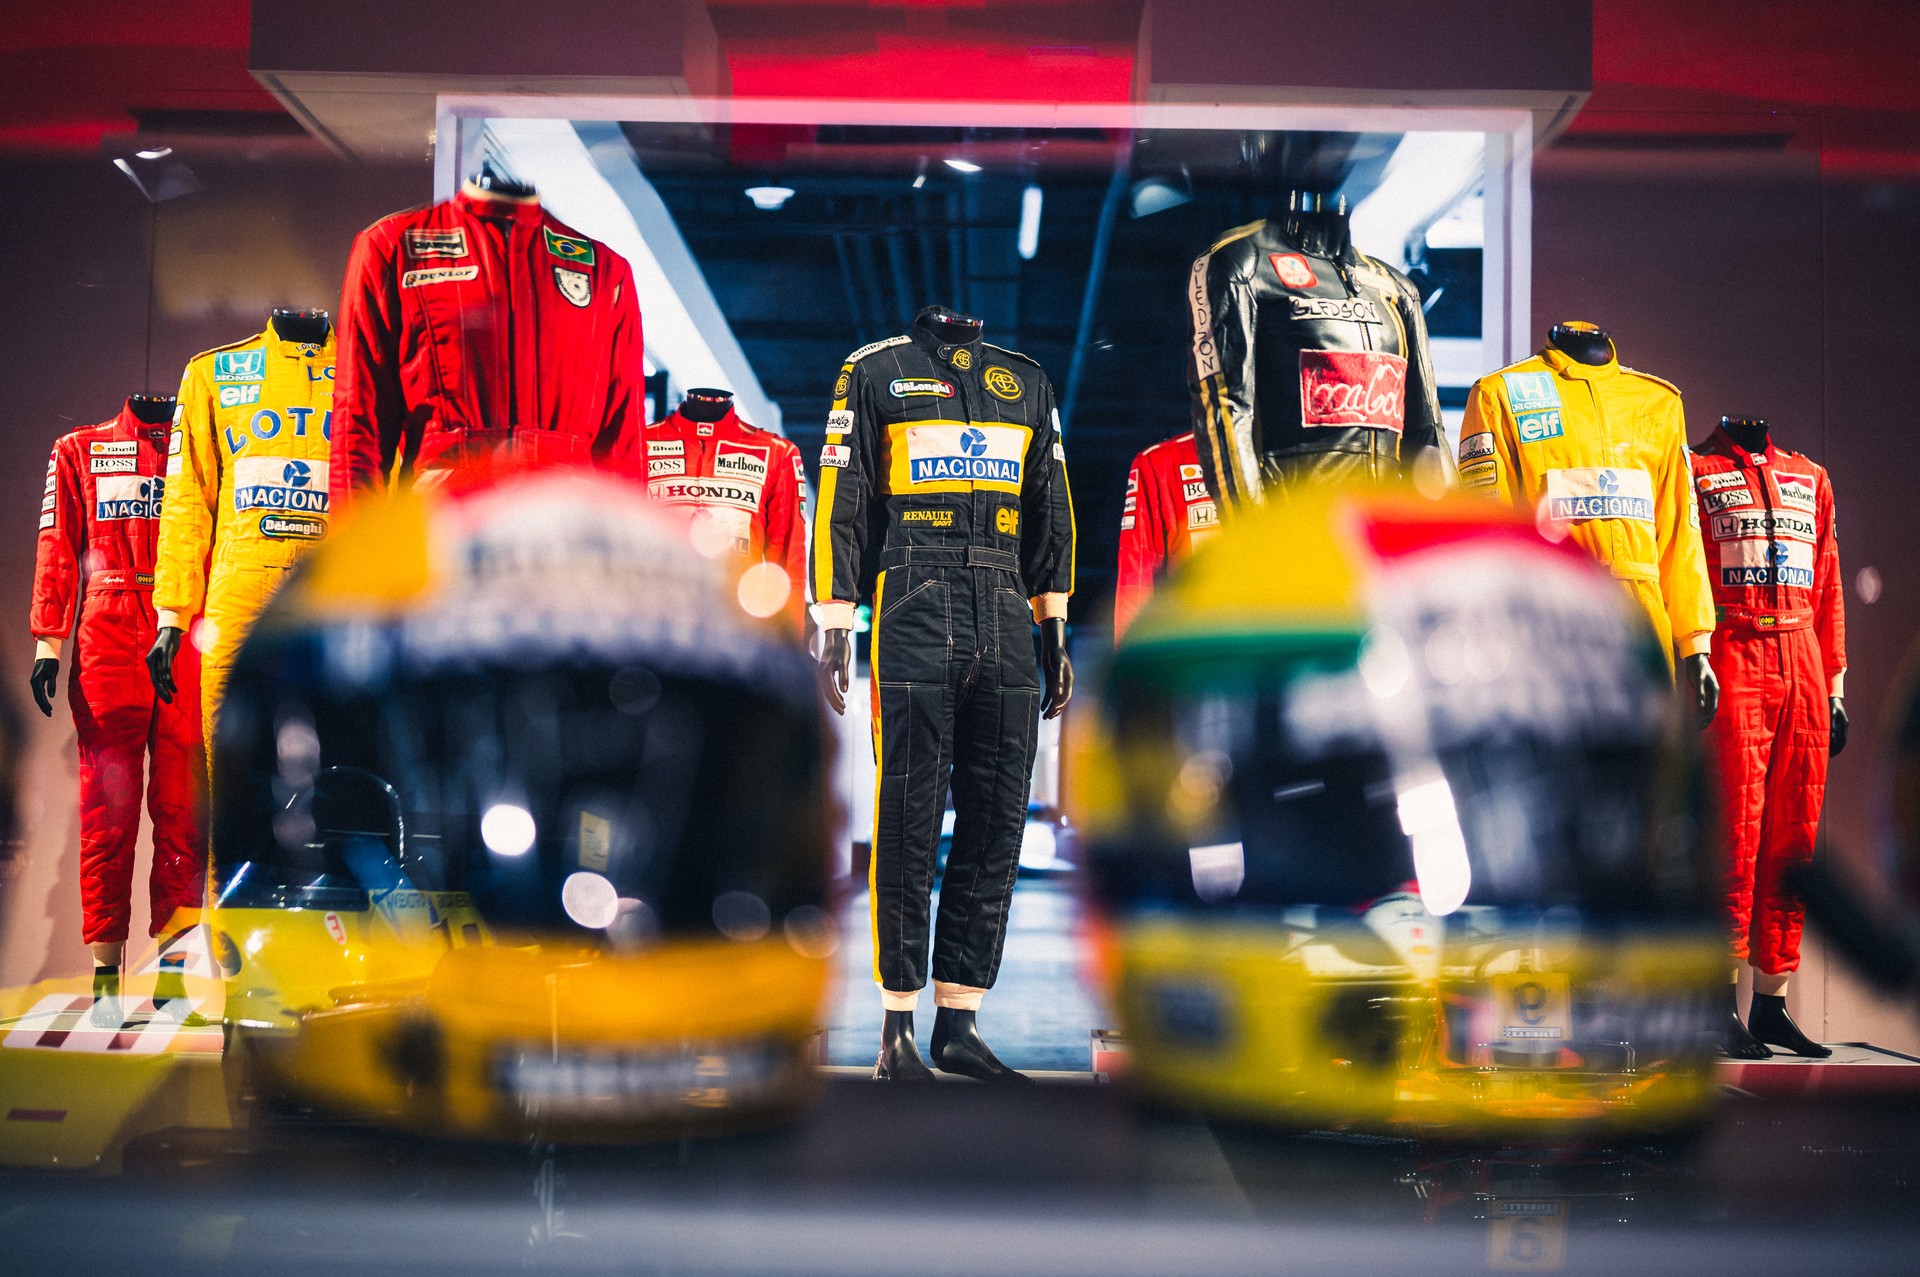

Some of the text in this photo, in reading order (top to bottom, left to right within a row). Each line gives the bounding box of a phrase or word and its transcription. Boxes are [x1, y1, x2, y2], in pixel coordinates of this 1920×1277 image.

[421, 271, 472, 280] DUNLOP
[296, 343, 321, 352] LOTUS
[220, 384, 260, 406] elf
[224, 405, 332, 455] LOT
[1521, 413, 1559, 439] elf
[95, 459, 133, 468] BOSS
[717, 456, 765, 474] Marlboro
[820, 458, 848, 466] ROMAX
[918, 457, 1019, 481] NACIONAL
[240, 488, 329, 511] NACION
[666, 485, 757, 504] HONDA
[1707, 490, 1749, 509] BOSS
[105, 502, 162, 517] NACIO
[903, 511, 953, 521] RENAULT
[1559, 499, 1652, 518] NACIONAL
[996, 507, 1019, 536] elf
[1741, 518, 1814, 535] HONDA
[1729, 569, 1812, 587] NACIONAL
